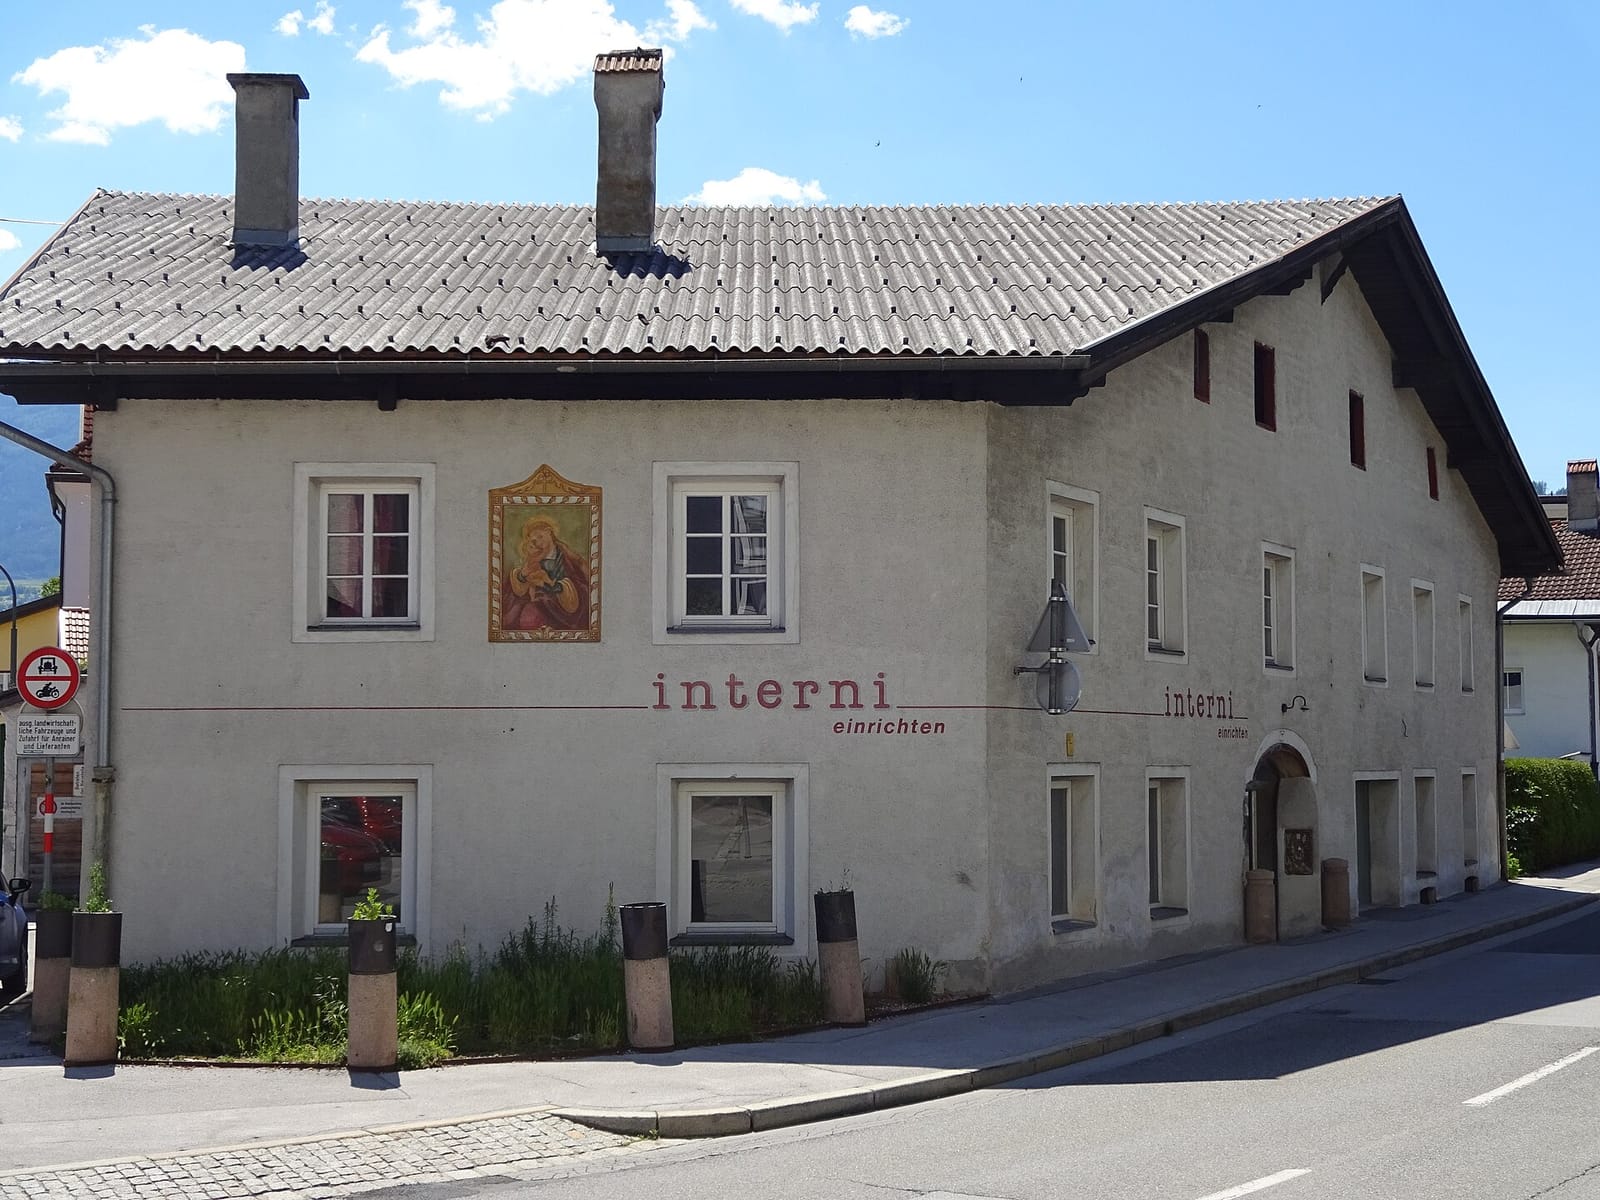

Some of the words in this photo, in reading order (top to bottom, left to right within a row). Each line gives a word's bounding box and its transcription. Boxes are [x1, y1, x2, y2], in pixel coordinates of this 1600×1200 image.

[652, 672, 891, 710] interni
[1165, 685, 1234, 719] interni
[18, 727, 33, 735] liche
[34, 727, 64, 736] Fahrzeuge
[65, 727, 77, 735] und
[833, 718, 946, 735] einrichten
[1218, 725, 1249, 740] einrichten
[23, 742, 35, 750] und
[36, 742, 71, 750] Lieferanten
